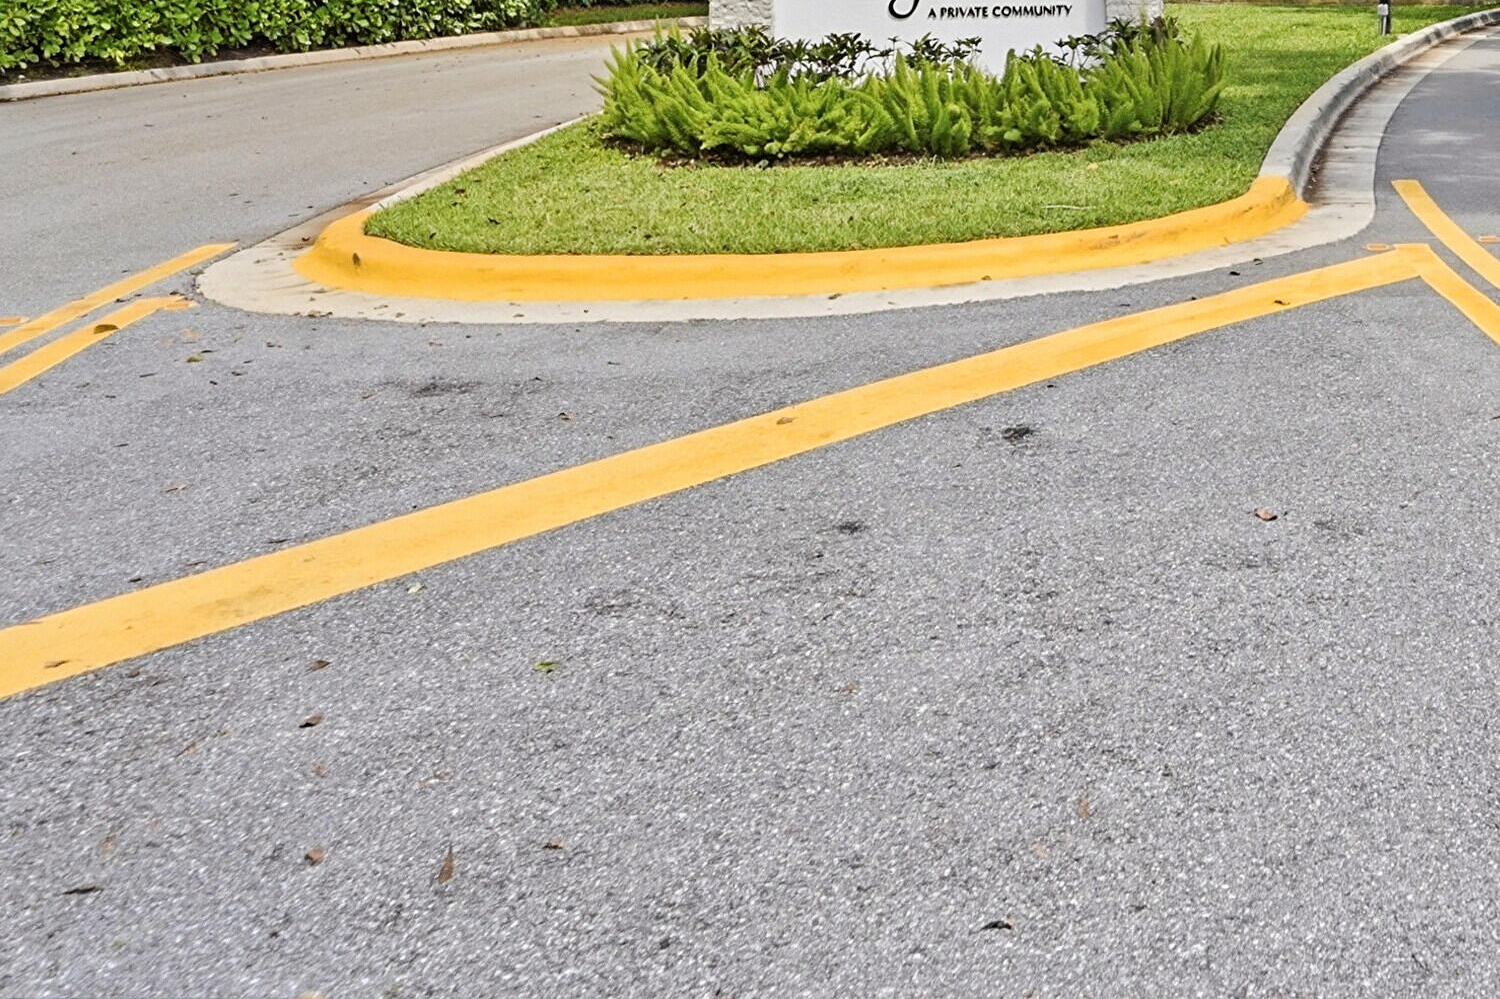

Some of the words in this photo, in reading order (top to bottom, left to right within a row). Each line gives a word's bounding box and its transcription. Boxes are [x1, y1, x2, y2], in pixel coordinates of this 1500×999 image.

[928, 7, 937, 19] A
[940, 6, 988, 19] PRIVATE
[992, 4, 1073, 18] COMMUNITY
